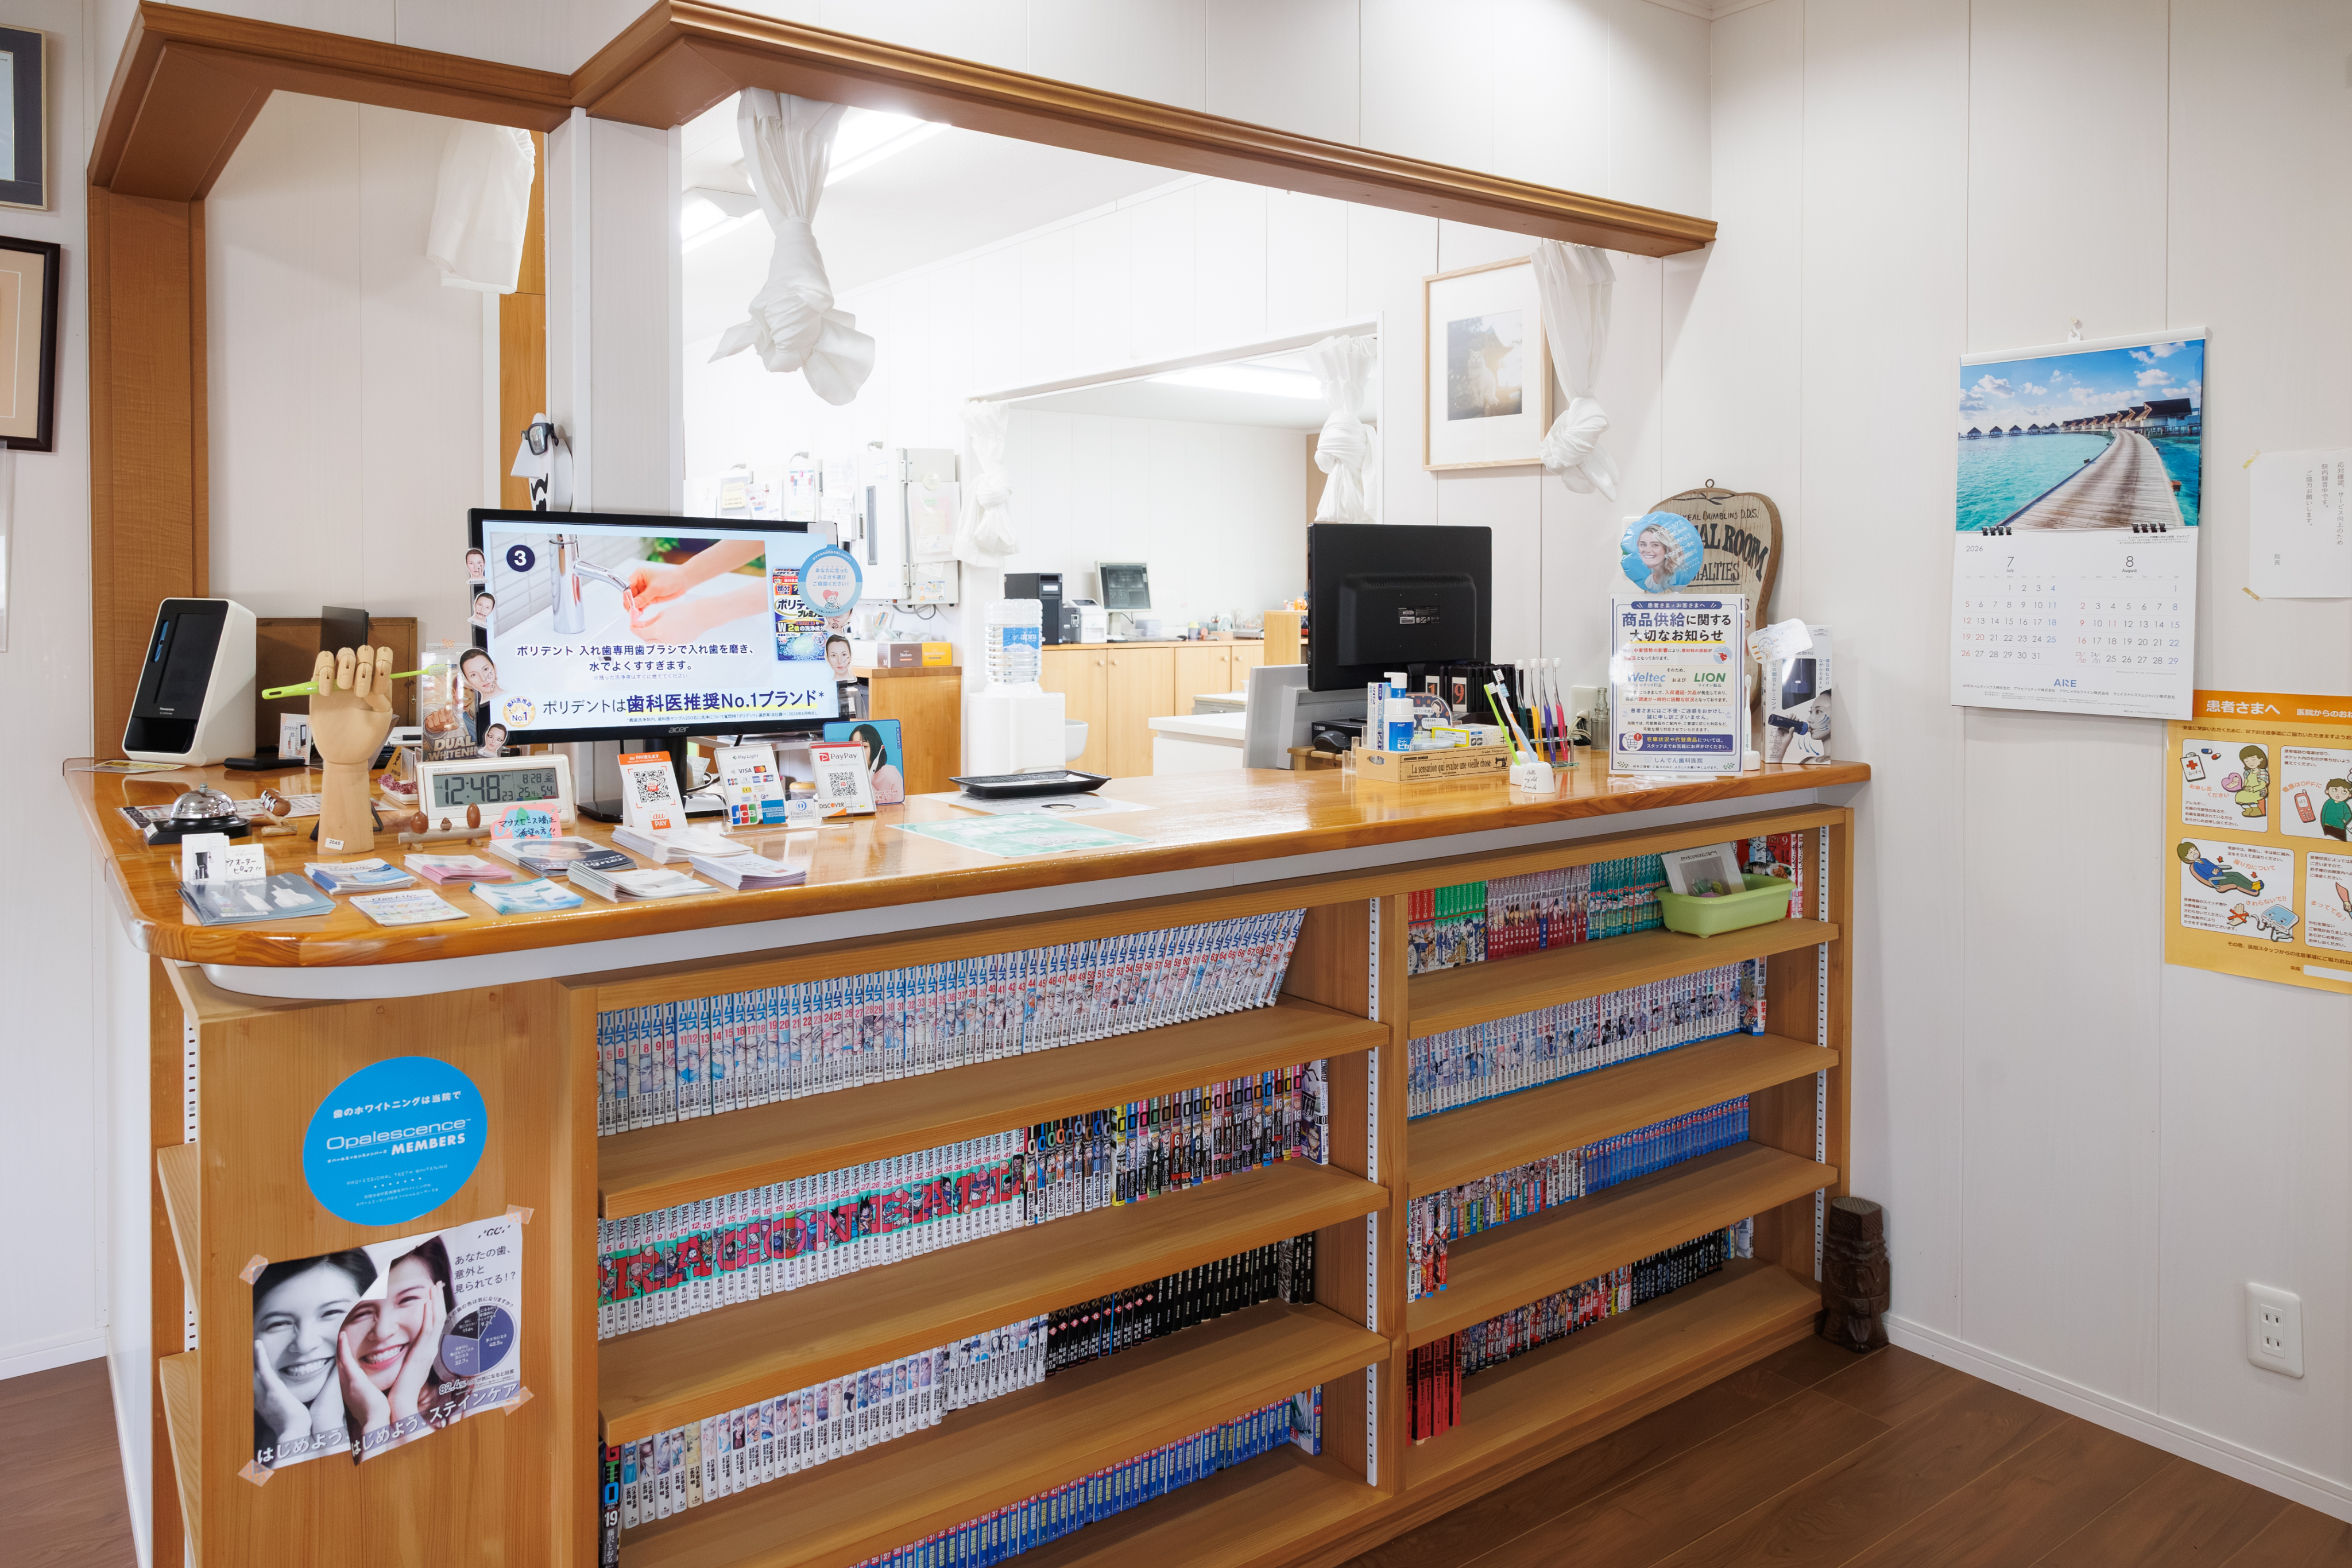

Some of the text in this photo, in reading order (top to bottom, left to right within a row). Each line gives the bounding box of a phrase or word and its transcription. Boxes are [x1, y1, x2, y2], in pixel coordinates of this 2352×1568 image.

[1740, 509, 1758, 518] D.D.S.
[514, 550, 526, 567] 3
[1722, 524, 1768, 582] ROOM
[2274, 553, 2281, 566] 院長
[2007, 556, 2014, 567] 7
[2125, 555, 2134, 568] 8
[1622, 612, 1731, 628] 商品供給に関する
[1020, 632, 1036, 642] alpina
[1630, 629, 1723, 642] 大切なお知らせ
[517, 644, 755, 657] ポリデント 入れ歯専用歯ブラシで入れ歯を磨き、
[589, 660, 693, 672] 水でよくすすぎます。
[1694, 672, 1726, 682] LION
[1454, 683, 1465, 704] 9
[2206, 699, 2281, 715] 患者さまへ
[434, 734, 475, 752] DUAL
[1411, 764, 1417, 773] La
[1418, 762, 1437, 773] sensation
[1446, 760, 1459, 771] evalue
[1468, 759, 1479, 769] vieille
[1481, 758, 1491, 768] chose
[531, 773, 541, 783] 28
[544, 772, 554, 782] 金
[445, 775, 513, 804] 12:48 23
[2282, 781, 2323, 793] 電源はOFFに
[732, 806, 757, 822] JCB
[498, 815, 556, 827] マウスピース矯正
[1782, 836, 1788, 845] 9
[2233, 859, 2276, 871] 座り方について
[644, 1043, 649, 1053] 8
[656, 1041, 662, 1051] 9
[666, 1039, 675, 1049] 10
[333, 1090, 462, 1119] 歯のホワイトニングは当院で
[1275, 1098, 1282, 1109] 16
[1294, 1110, 1301, 1121] 18
[392, 1133, 466, 1156] MEMBERS
[691, 1222, 700, 1230] 12
[455, 1245, 510, 1265] あなたの歯、
[454, 1265, 485, 1280] 意外と
[454, 1271, 516, 1294] 見られてる!?
[351, 1384, 518, 1457] はじめよう、ステインケア
[605, 1510, 618, 1527] 19
